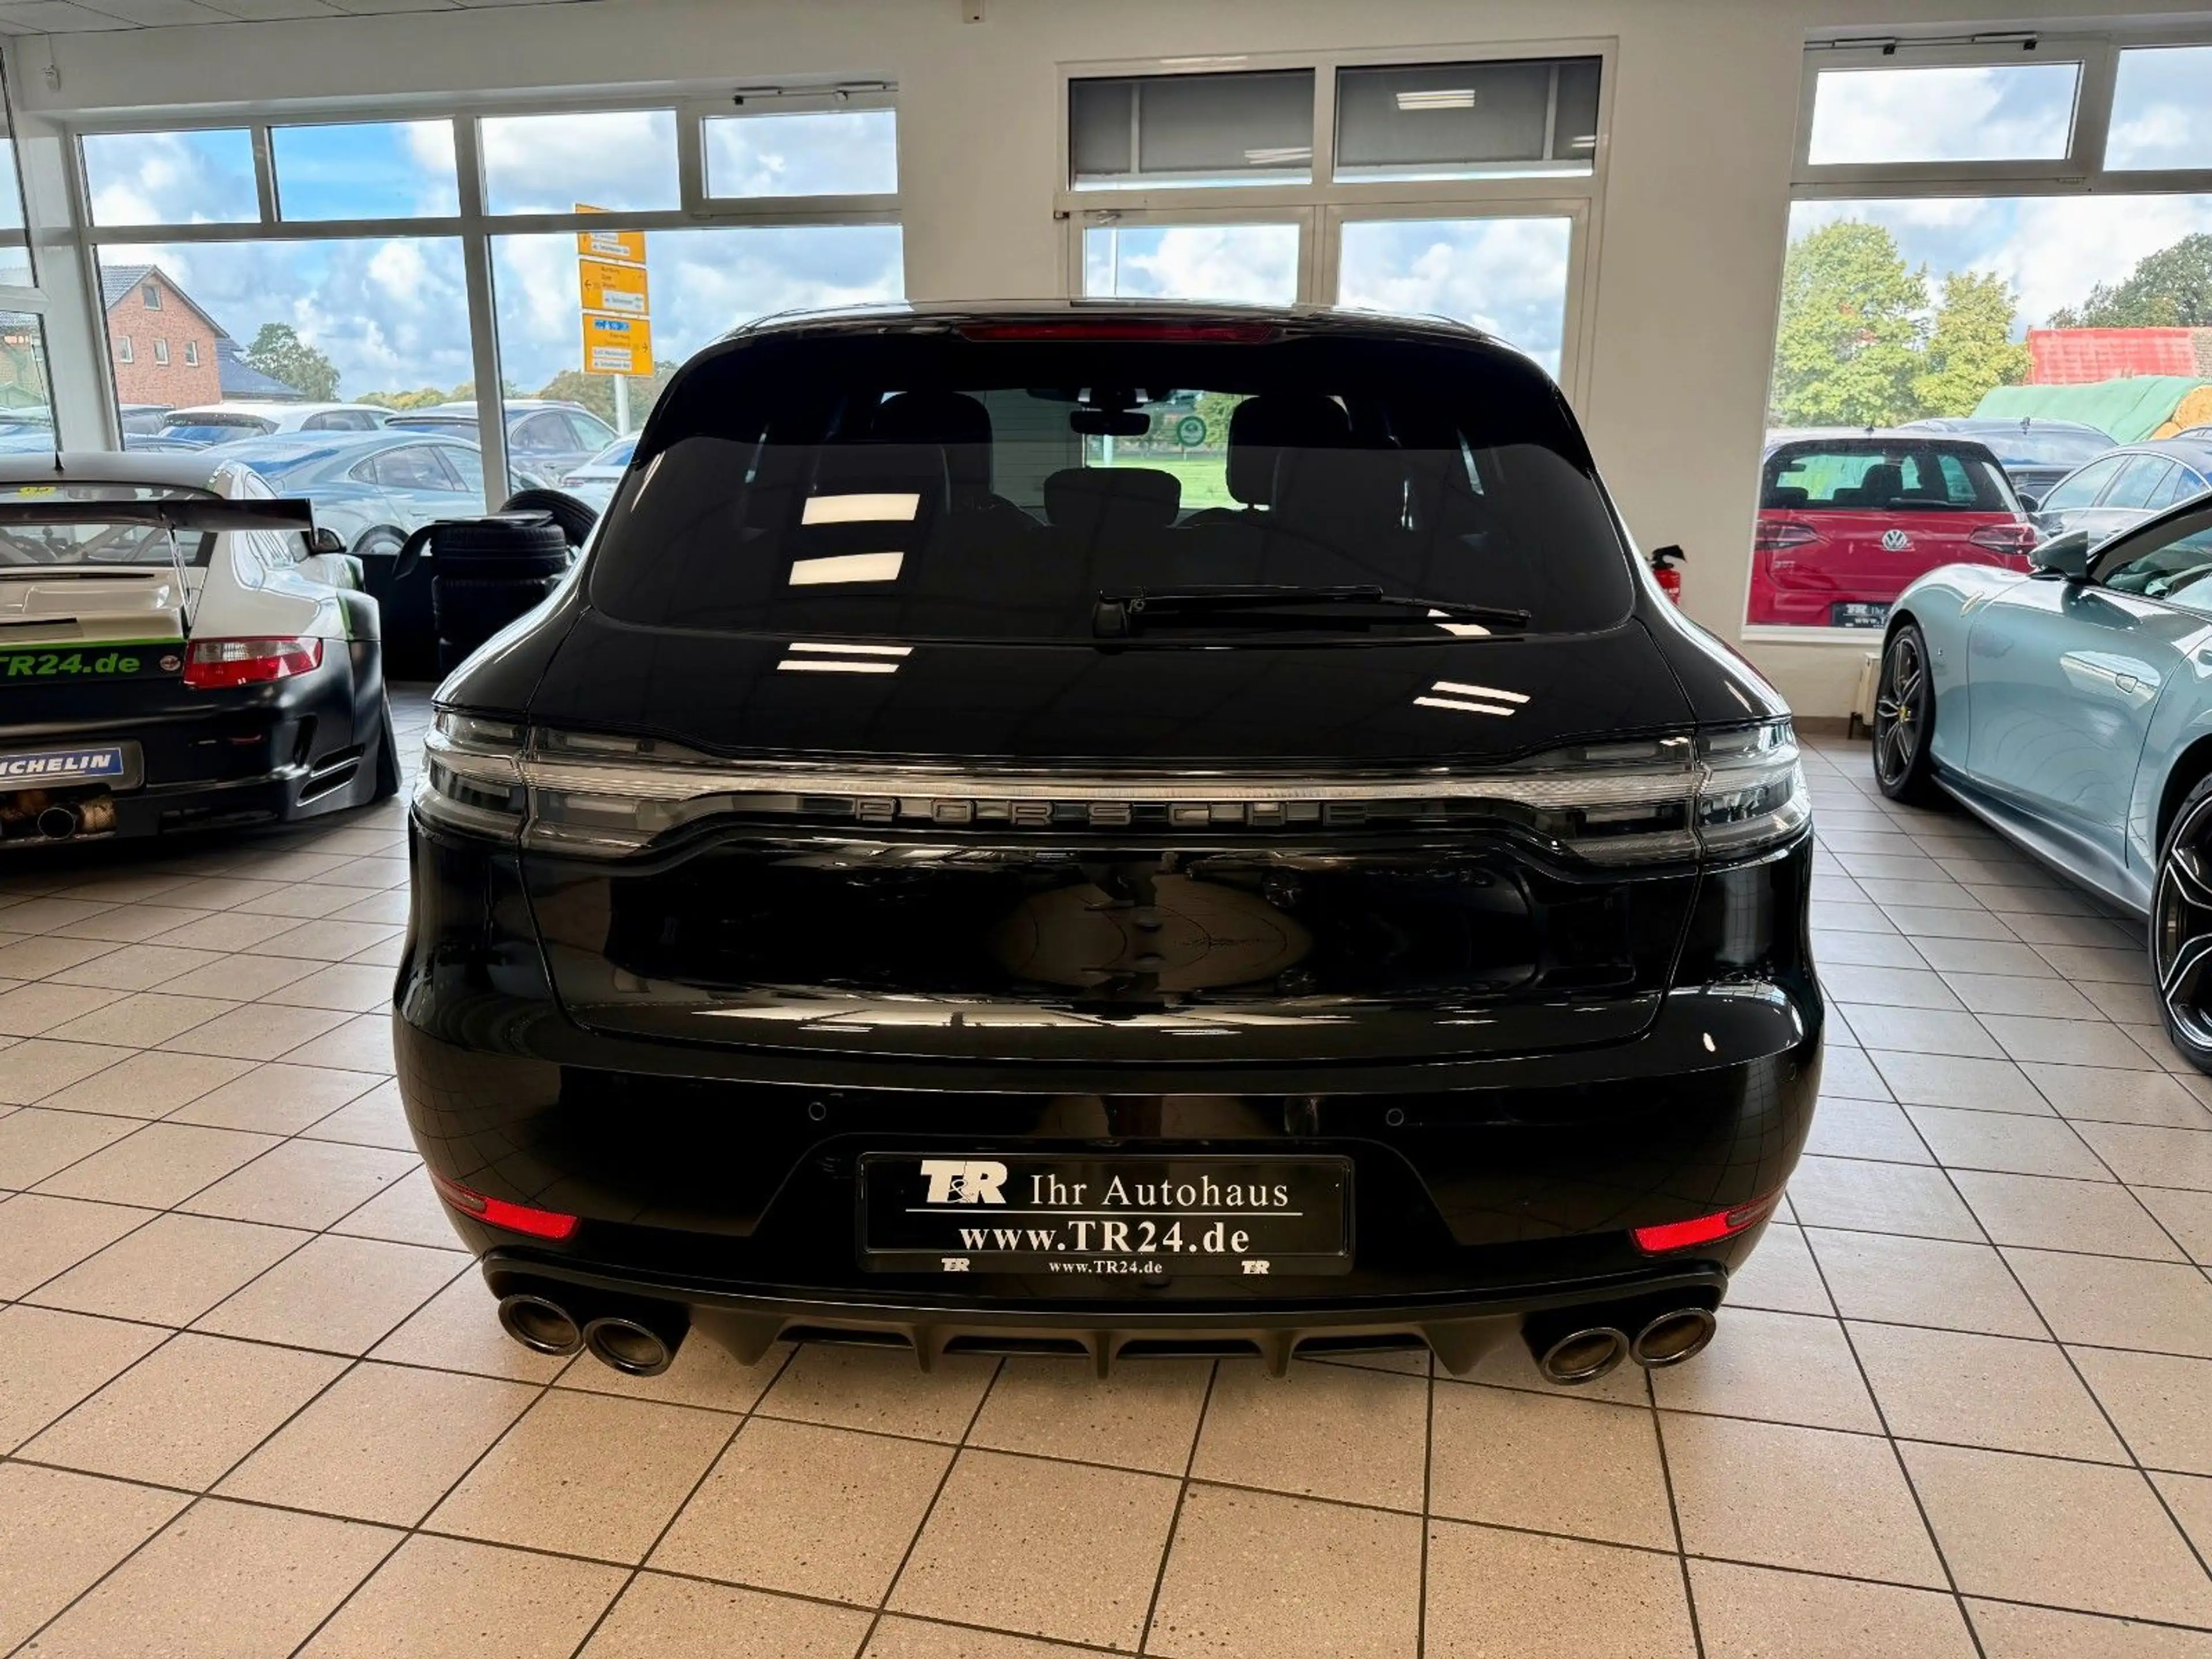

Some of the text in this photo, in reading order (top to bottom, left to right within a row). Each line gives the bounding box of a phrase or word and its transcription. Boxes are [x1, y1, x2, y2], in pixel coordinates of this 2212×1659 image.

[0, 755, 111, 775] ICHELIN
[855, 798, 1366, 826] PORSCHE
[921, 1160, 1289, 1207] T&R Ihr Autohaus
[958, 1220, 1250, 1253] www.TR24.de
[1048, 1260, 1162, 1274] www.TR24.de
